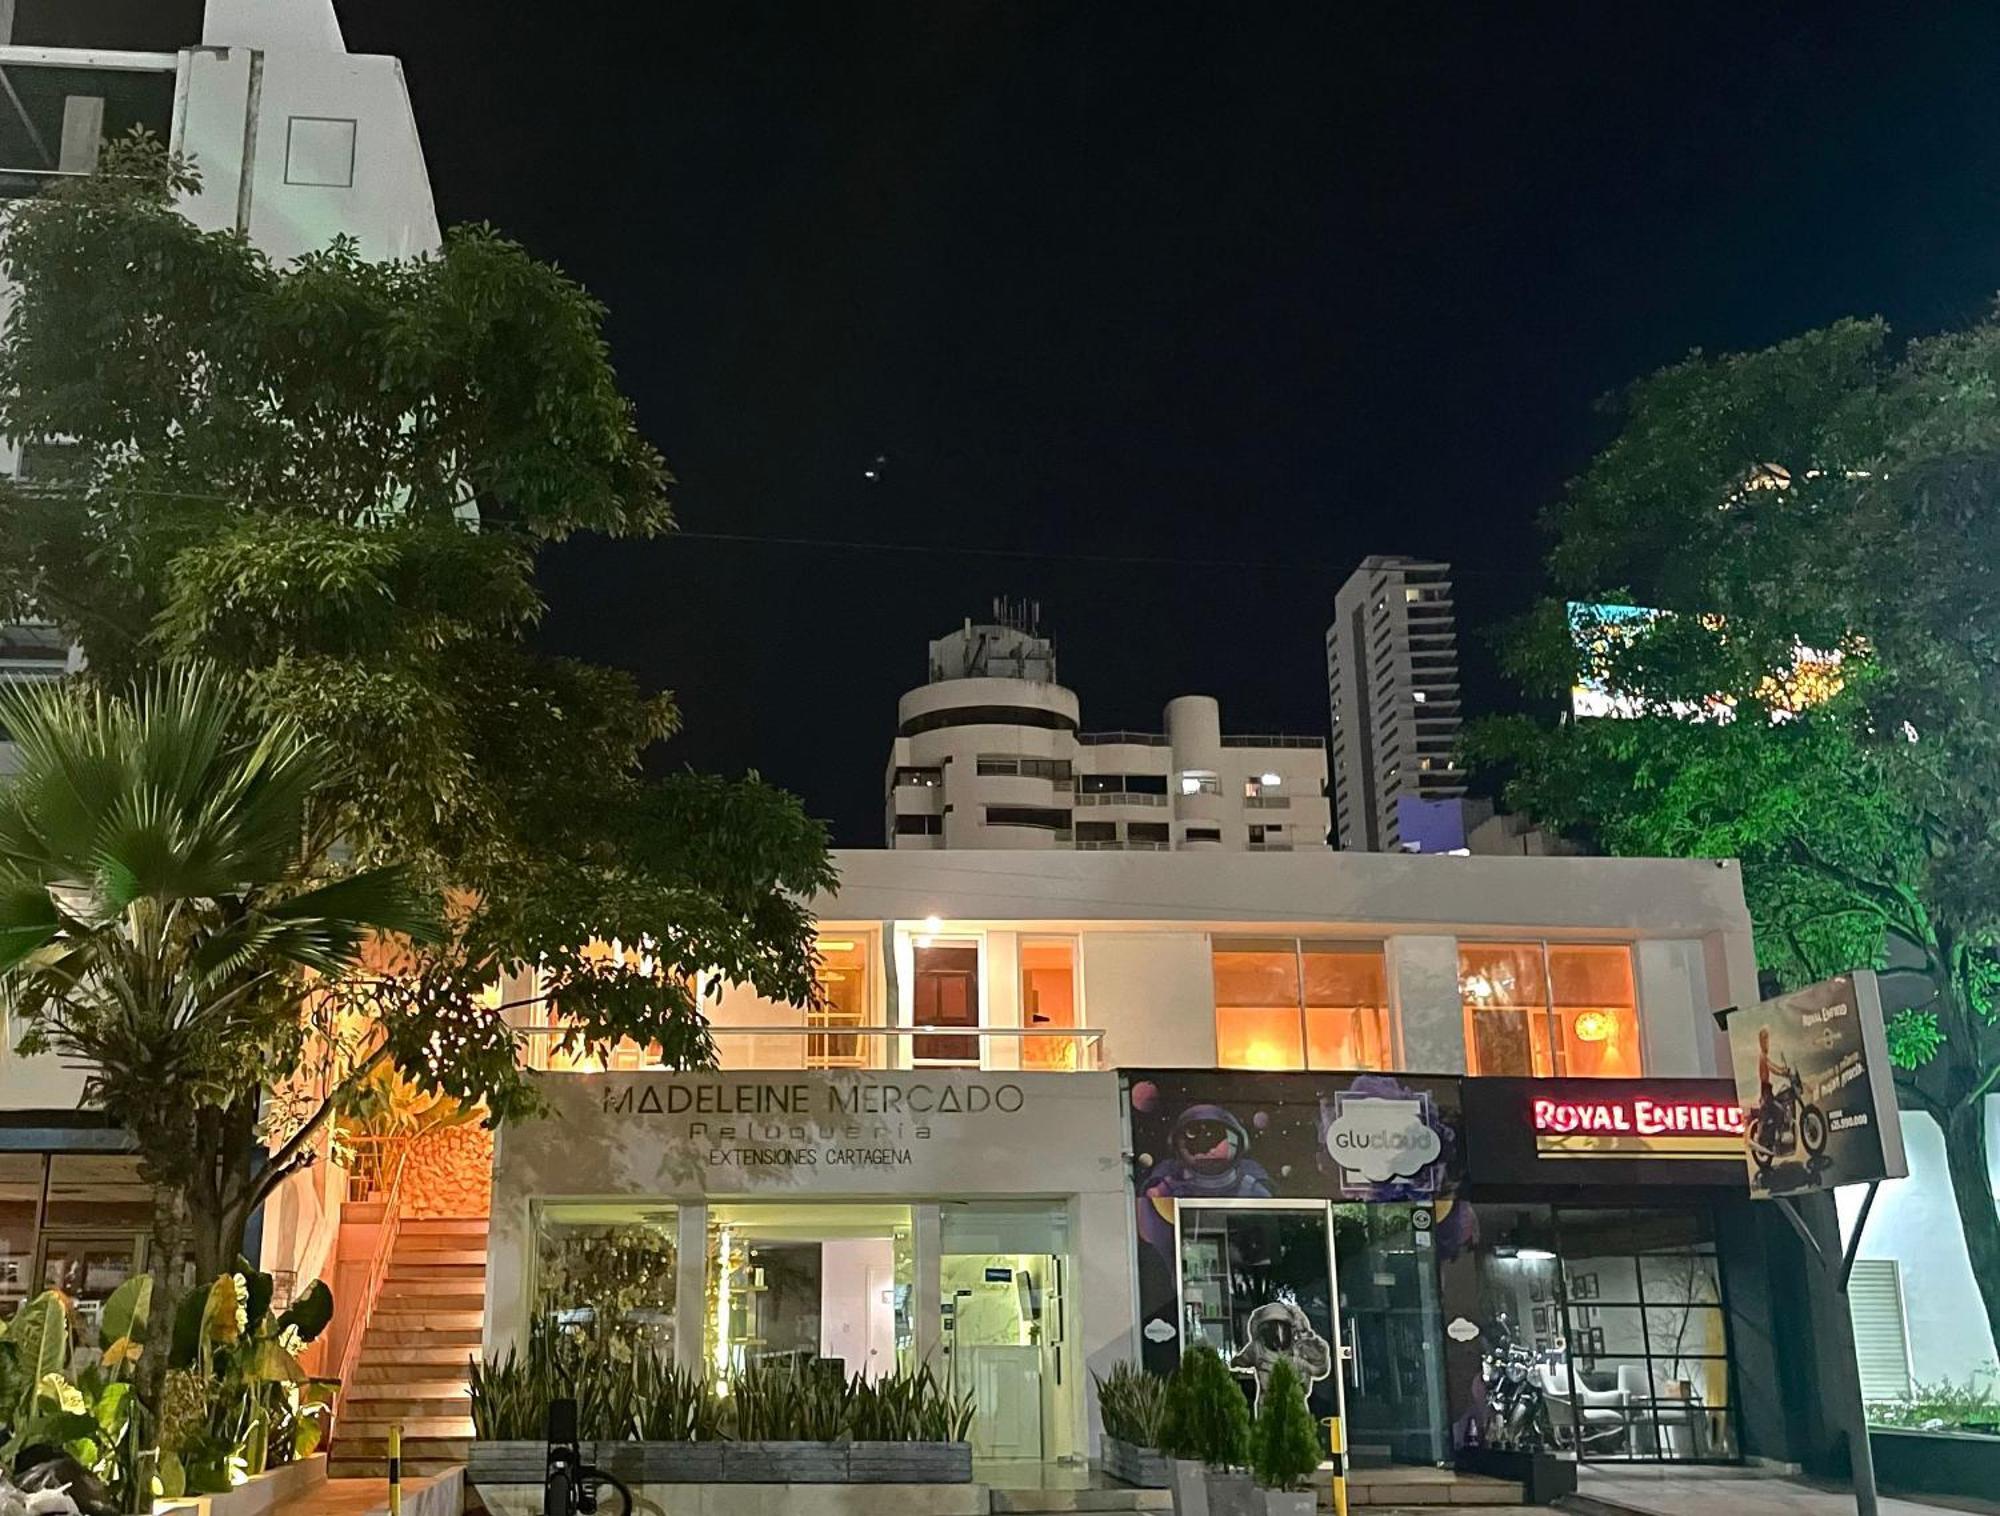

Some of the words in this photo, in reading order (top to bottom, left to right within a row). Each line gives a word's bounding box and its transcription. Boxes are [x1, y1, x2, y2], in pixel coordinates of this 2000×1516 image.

[603, 1085, 809, 1114] MADELEINE
[828, 1084, 1024, 1114] MERCADO
[1534, 1100, 1630, 1132] ROYAL
[1634, 1101, 1745, 1134] ENFIELD
[710, 1149, 817, 1165] EXTENSIONES
[826, 1149, 912, 1165] CARTAGENA
